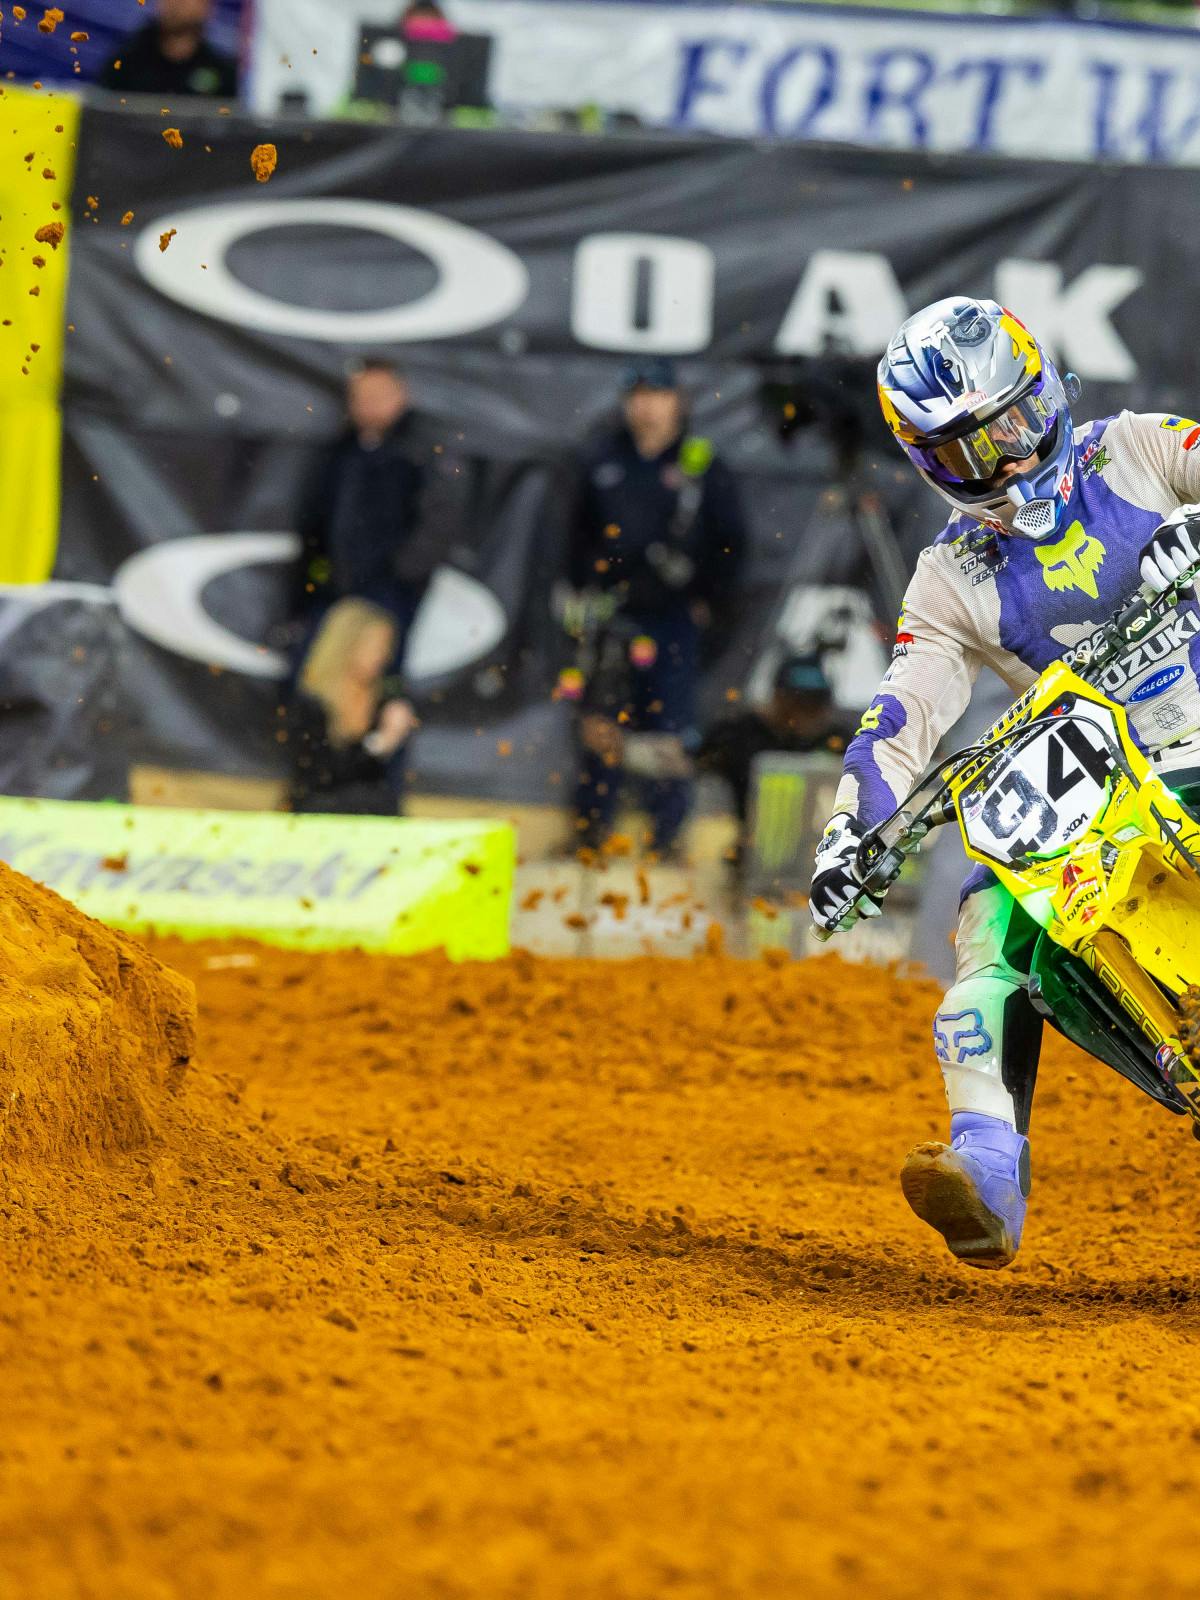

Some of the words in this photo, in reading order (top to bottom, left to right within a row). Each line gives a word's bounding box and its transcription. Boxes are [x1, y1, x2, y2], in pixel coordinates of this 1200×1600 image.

[672, 38, 1045, 152] FORT
[1174, 565, 1197, 588] ASV
[1125, 608, 1152, 640] ASV
[1066, 886, 1102, 922] DIXXON
